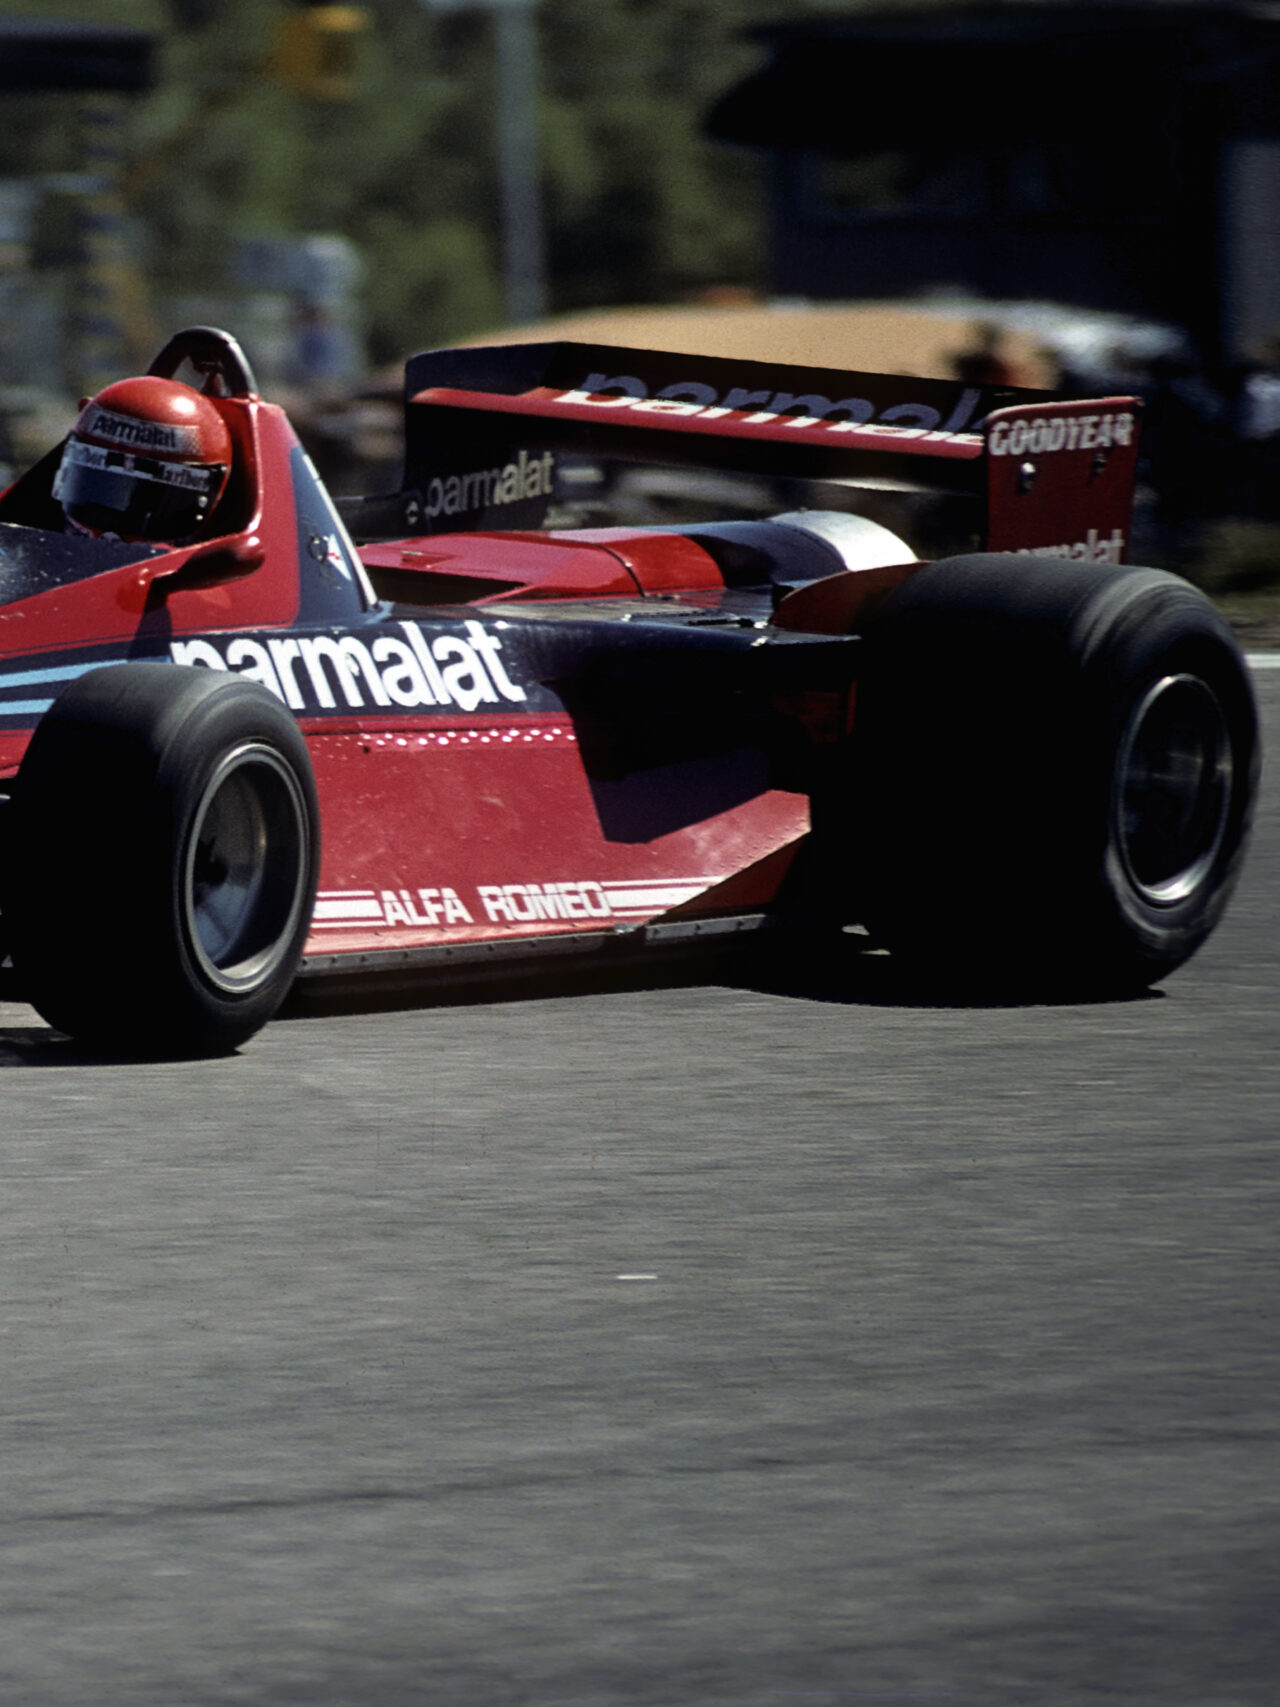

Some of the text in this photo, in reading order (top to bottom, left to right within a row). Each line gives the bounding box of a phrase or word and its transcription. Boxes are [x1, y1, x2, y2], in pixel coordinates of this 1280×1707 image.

[93, 414, 176, 448] parmalat
[554, 373, 984, 446] parmal
[989, 413, 1134, 456] GOODYEAR
[424, 450, 554, 517] parmalat
[381, 881, 612, 926] ALFA ROMEO
